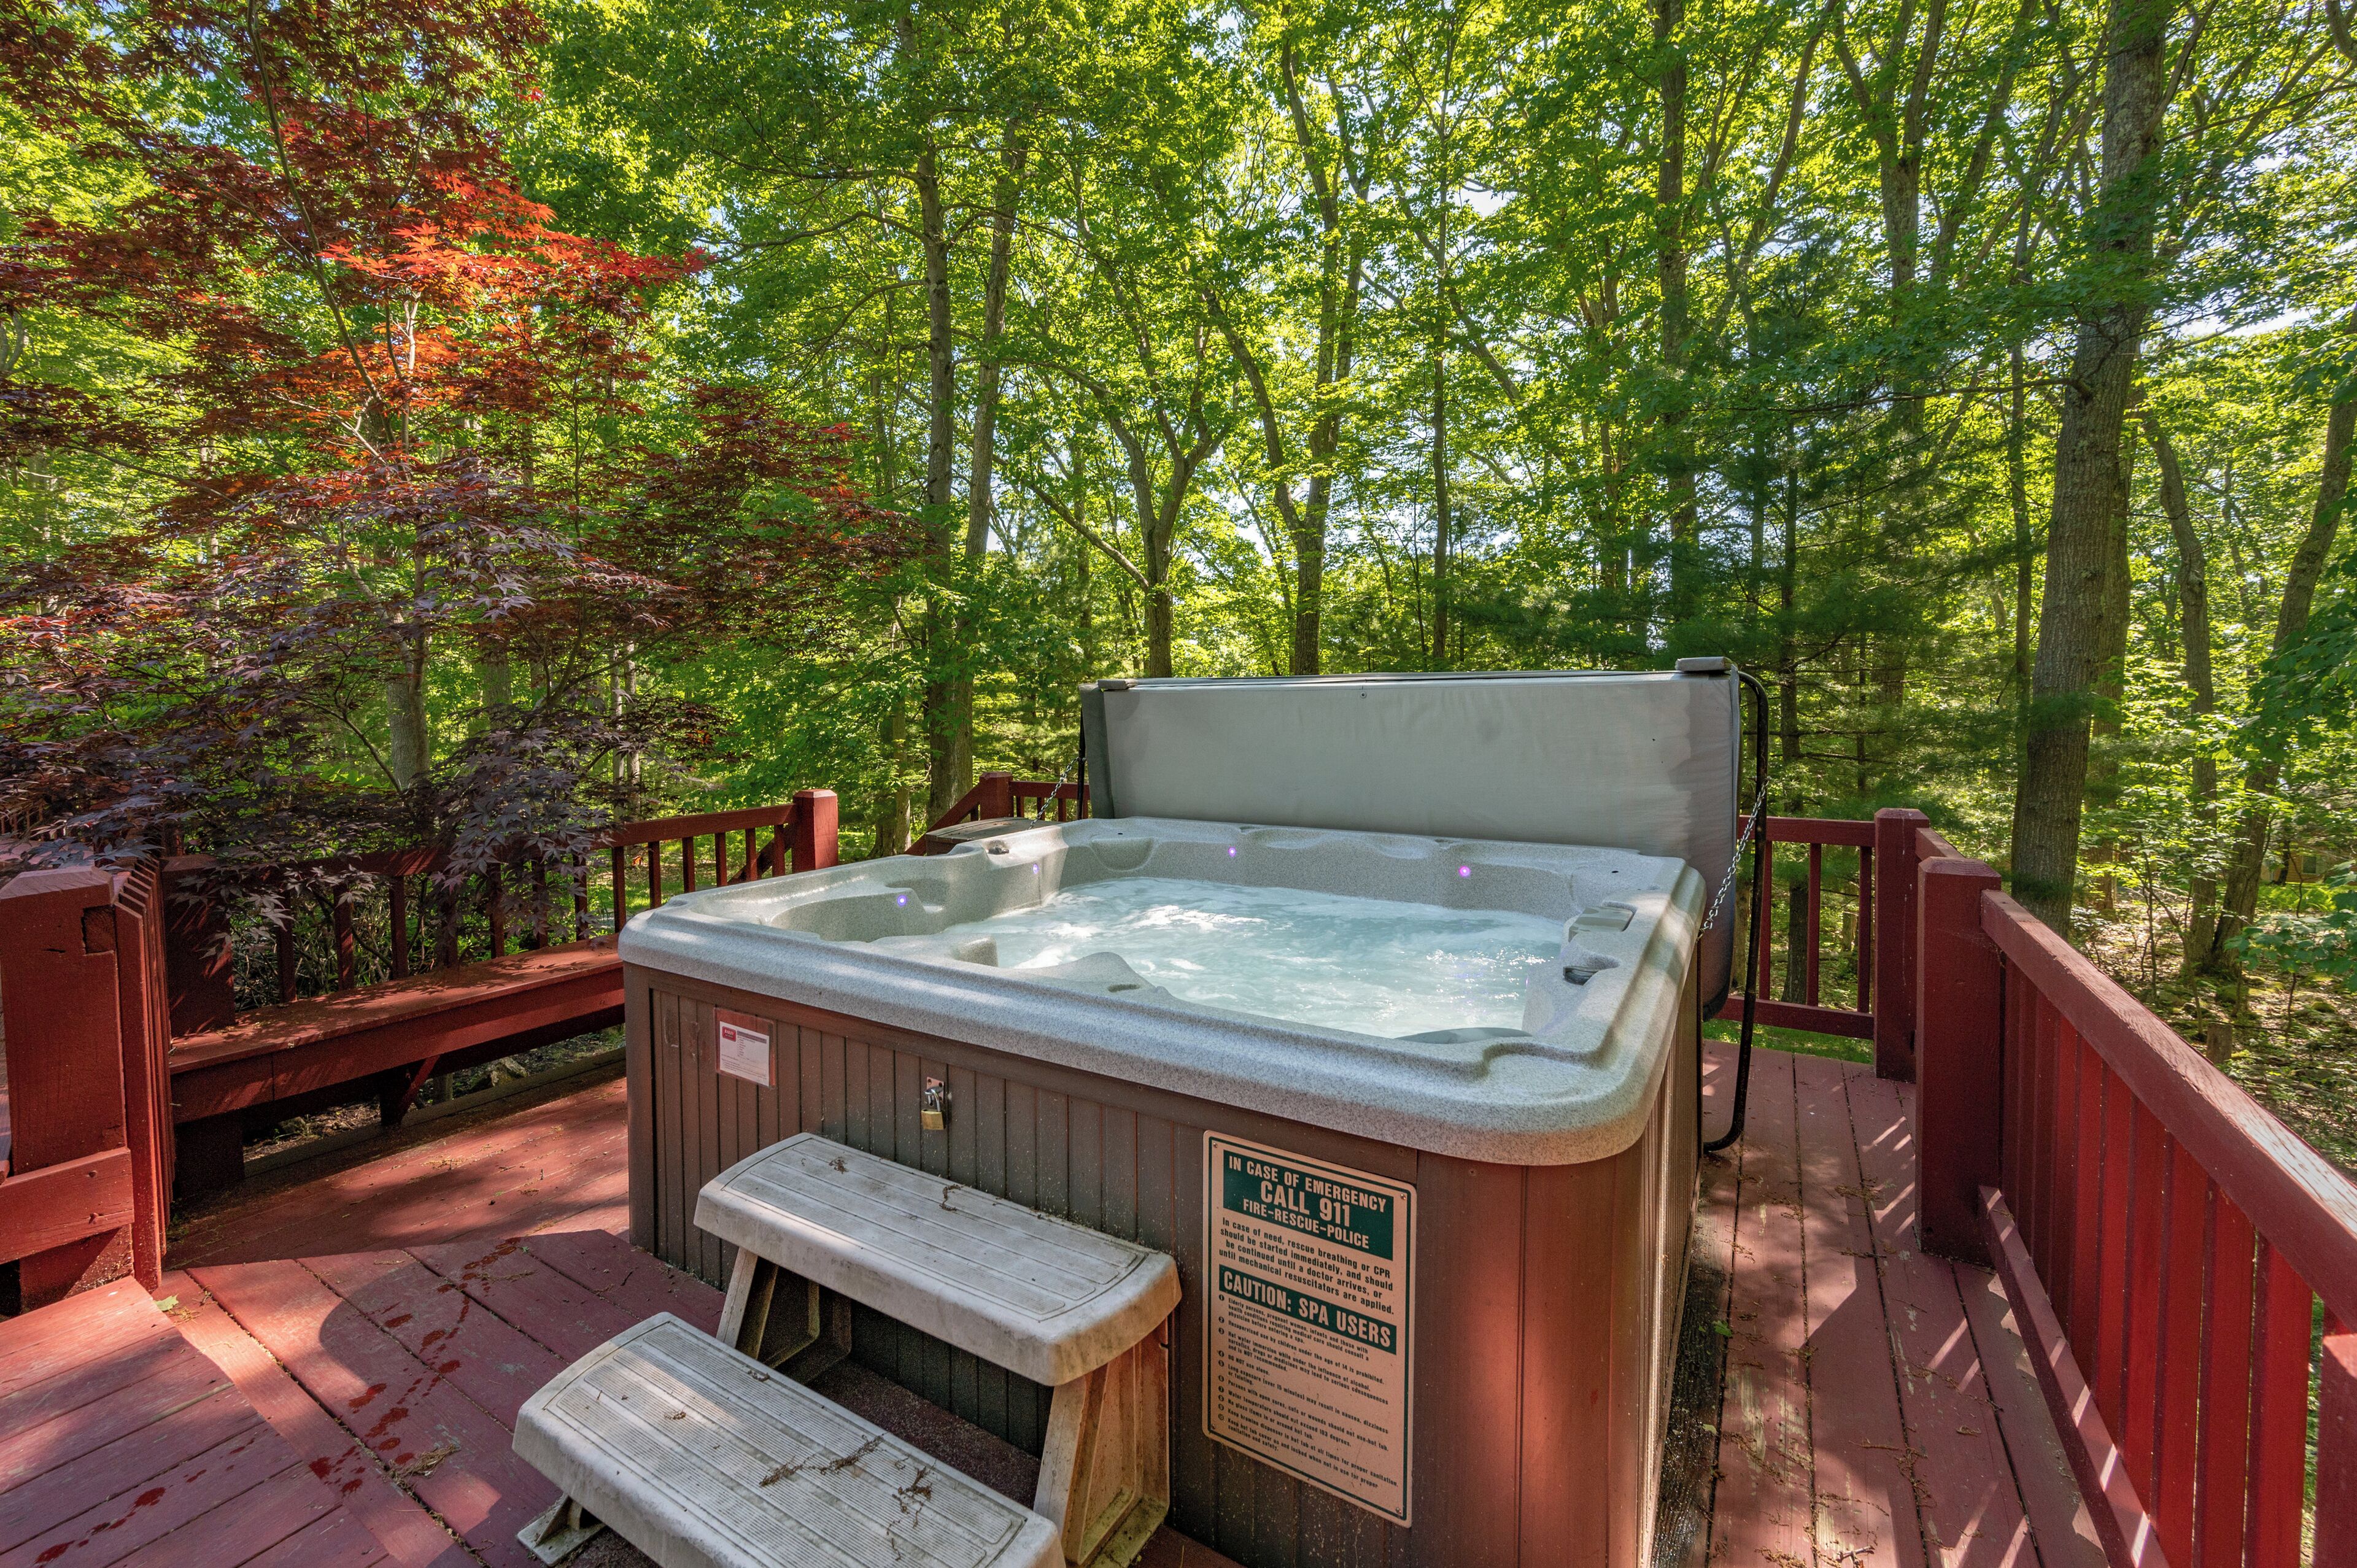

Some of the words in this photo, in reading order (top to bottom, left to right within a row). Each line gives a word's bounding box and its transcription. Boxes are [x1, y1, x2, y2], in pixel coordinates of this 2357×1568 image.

[1229, 1156, 1241, 1171] IN
[1247, 1161, 1278, 1182] CASE
[1284, 1171, 1299, 1187] OF
[1305, 1177, 1386, 1213] EMERGENCY
[1261, 1180, 1310, 1215] CALL
[1319, 1197, 1350, 1227] 911
[1223, 1217, 1229, 1227] In
[1232, 1222, 1250, 1233] case
[1253, 1228, 1261, 1237] of
[1264, 1232, 1284, 1245] need,
[1287, 1240, 1314, 1254] rescue
[1318, 1247, 1357, 1270] breathing
[1361, 1263, 1370, 1272] or
[1374, 1265, 1390, 1279] CPR
[1243, 1199, 1369, 1249] FIRE-RESCUE-POLICE
[1219, 1249, 1236, 1260] until
[1239, 1256, 1282, 1276] mechanical
[1285, 1271, 1339, 1296] resuscitators
[1343, 1291, 1357, 1302] are
[1360, 1297, 1394, 1315] applied.
[1220, 1228, 1244, 1242] should
[1247, 1235, 1256, 1246] be
[1259, 1241, 1288, 1256] started
[1291, 1249, 1342, 1276] immediately,
[1346, 1270, 1361, 1281] and
[1364, 1275, 1393, 1291] should
[1226, 1239, 1234, 1249] be
[1237, 1245, 1274, 1263] continued
[1277, 1258, 1295, 1270] until
[1307, 1267, 1333, 1283] doctor
[1337, 1278, 1369, 1296] arrives,
[1373, 1290, 1382, 1299] or
[1224, 1271, 1291, 1311] CAUTION:
[1298, 1297, 1329, 1326] SPA
[1336, 1310, 1390, 1347] USERS
